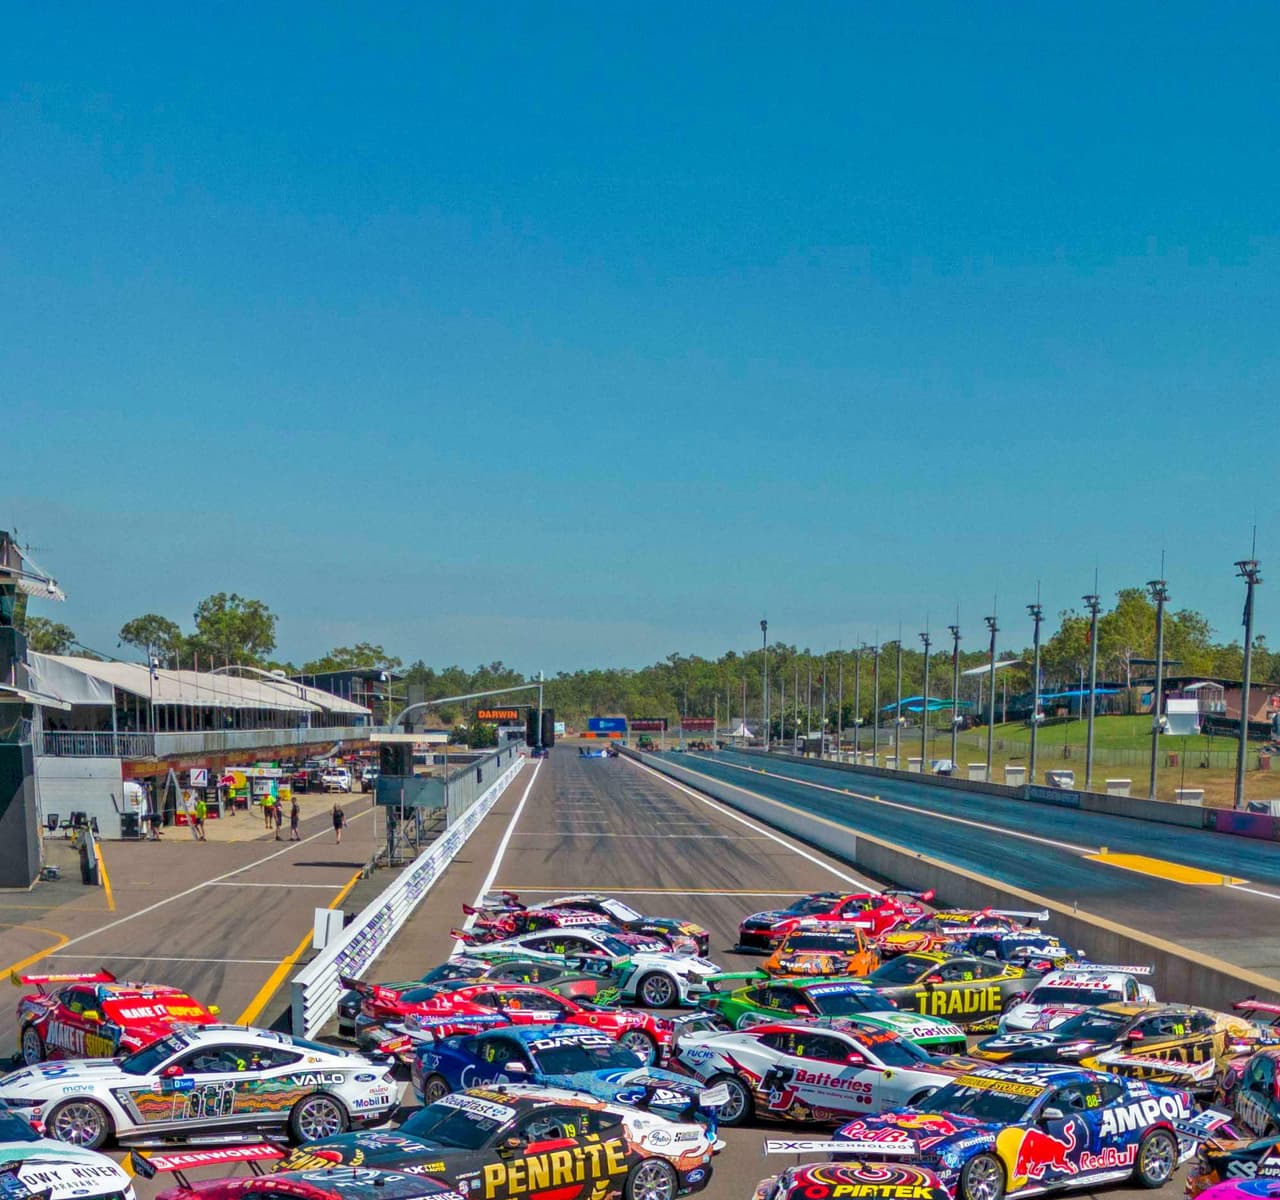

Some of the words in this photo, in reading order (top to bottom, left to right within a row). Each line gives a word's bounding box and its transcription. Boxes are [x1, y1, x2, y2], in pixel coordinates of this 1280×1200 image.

[478, 710, 518, 719] DARWIN
[1047, 978, 1113, 991] Liberty
[915, 986, 1002, 1016] TRADIE
[912, 1025, 963, 1038] Castrol
[687, 1049, 715, 1060] FUCHS
[796, 1045, 805, 1056] 8
[236, 1059, 247, 1071] 2
[291, 1073, 346, 1086] VAILO
[795, 1069, 873, 1093] Batteries
[62, 1084, 95, 1094] move
[991, 1081, 1044, 1097] STORAGE
[172, 1080, 236, 1121] nti
[355, 1096, 380, 1109] Mobil
[440, 1095, 494, 1118] Steadfast
[1086, 1094, 1099, 1108] 88
[1099, 1094, 1191, 1138] AMPOL
[563, 1123, 576, 1139] 19
[840, 1120, 880, 1139] Red
[1176, 1123, 1209, 1139] DAF
[768, 1142, 813, 1150] DXC
[819, 1143, 915, 1151] TECHNOLOGY
[170, 1146, 279, 1166] KENWORTH
[1080, 1150, 1106, 1171] Red
[1106, 1144, 1139, 1167] Bull
[483, 1138, 630, 1200] PENRITE
[832, 1184, 934, 1200] PIRTEK
